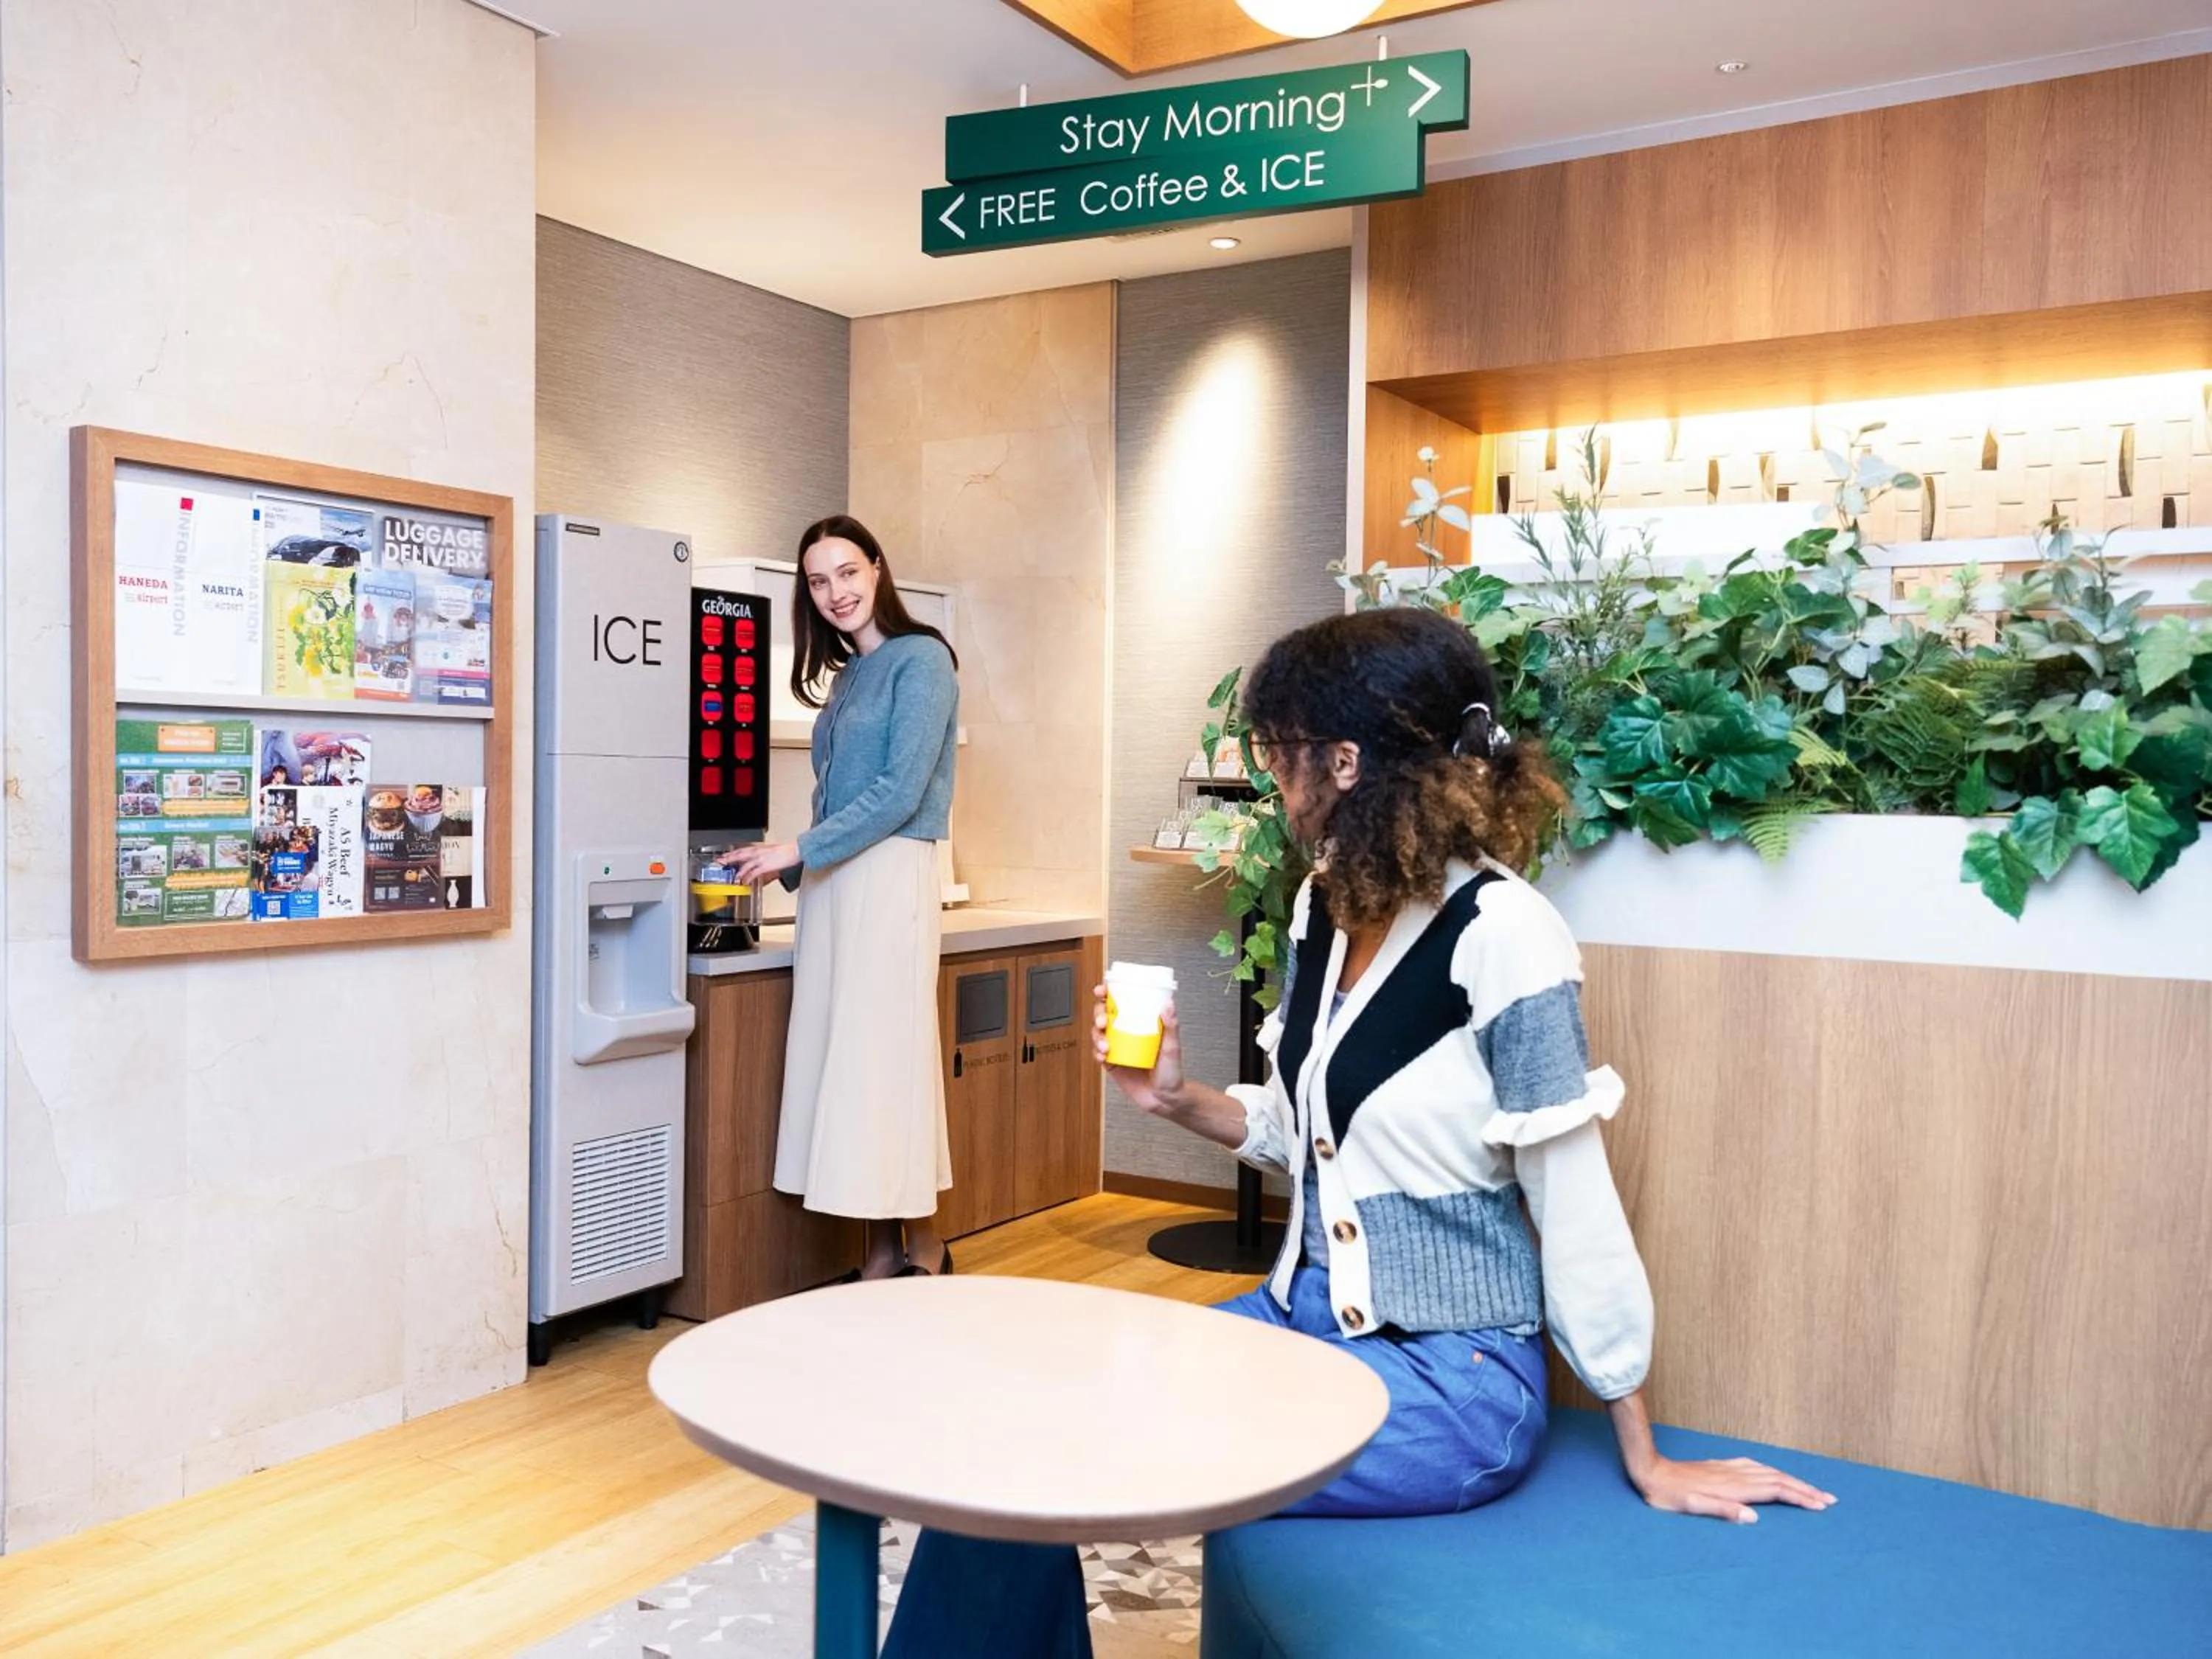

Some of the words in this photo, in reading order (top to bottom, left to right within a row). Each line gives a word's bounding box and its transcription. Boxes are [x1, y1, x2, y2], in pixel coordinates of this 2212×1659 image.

[1060, 115, 1150, 154] Stay
[1164, 88, 1347, 142] Morning
[978, 188, 1057, 229] FREE
[1079, 173, 1208, 217] Coffee
[1220, 164, 1248, 199] &
[1261, 150, 1326, 192] ICE
[385, 518, 485, 549] LUGGAGE
[119, 576, 168, 590] HANEDA
[173, 510, 192, 637] INFORMATION
[202, 584, 244, 597] NARITA
[702, 597, 752, 618] GEORGIA
[593, 614, 662, 666] ICE
[327, 807, 338, 858] Miyazaki
[325, 859, 338, 897] Wagyu
[340, 849, 352, 877] Beef
